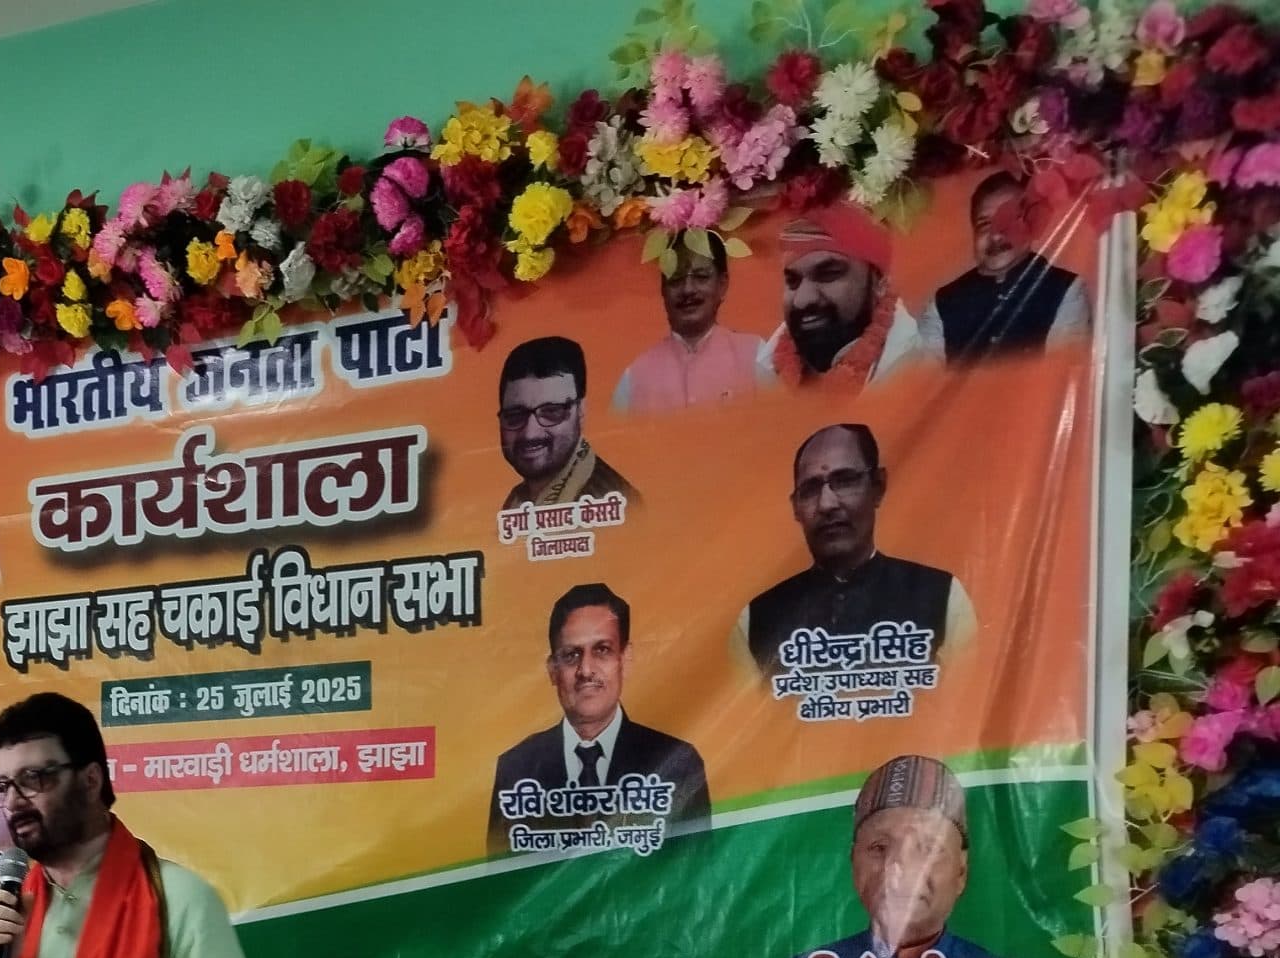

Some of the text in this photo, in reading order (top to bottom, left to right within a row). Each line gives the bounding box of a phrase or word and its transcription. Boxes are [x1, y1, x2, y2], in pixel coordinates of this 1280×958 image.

[12, 308, 449, 429] भारतीय जनता पाटी
[35, 433, 418, 544] कार्यशाला
[502, 496, 621, 539] दुर्गा प्रसाद केसरी
[6, 551, 478, 662] झाझा सह चकाई विधान सभा
[784, 624, 929, 665] धीरेन्द्र सिंह
[111, 684, 171, 716] दिनांक
[197, 687, 224, 711] 25
[232, 674, 293, 716] जुलाई
[302, 676, 361, 704] 2025
[776, 668, 935, 695] प्रदेश उपाध्यक्ष सह
[858, 691, 910, 718] प्रभारी
[144, 742, 233, 784] मारवाड़ी
[240, 739, 348, 775] धर्मशाला,
[357, 742, 427, 771] झाझा
[502, 777, 672, 816] रवि शंकर सिंह
[513, 827, 554, 848] जिला
[617, 821, 663, 854] जमुई
